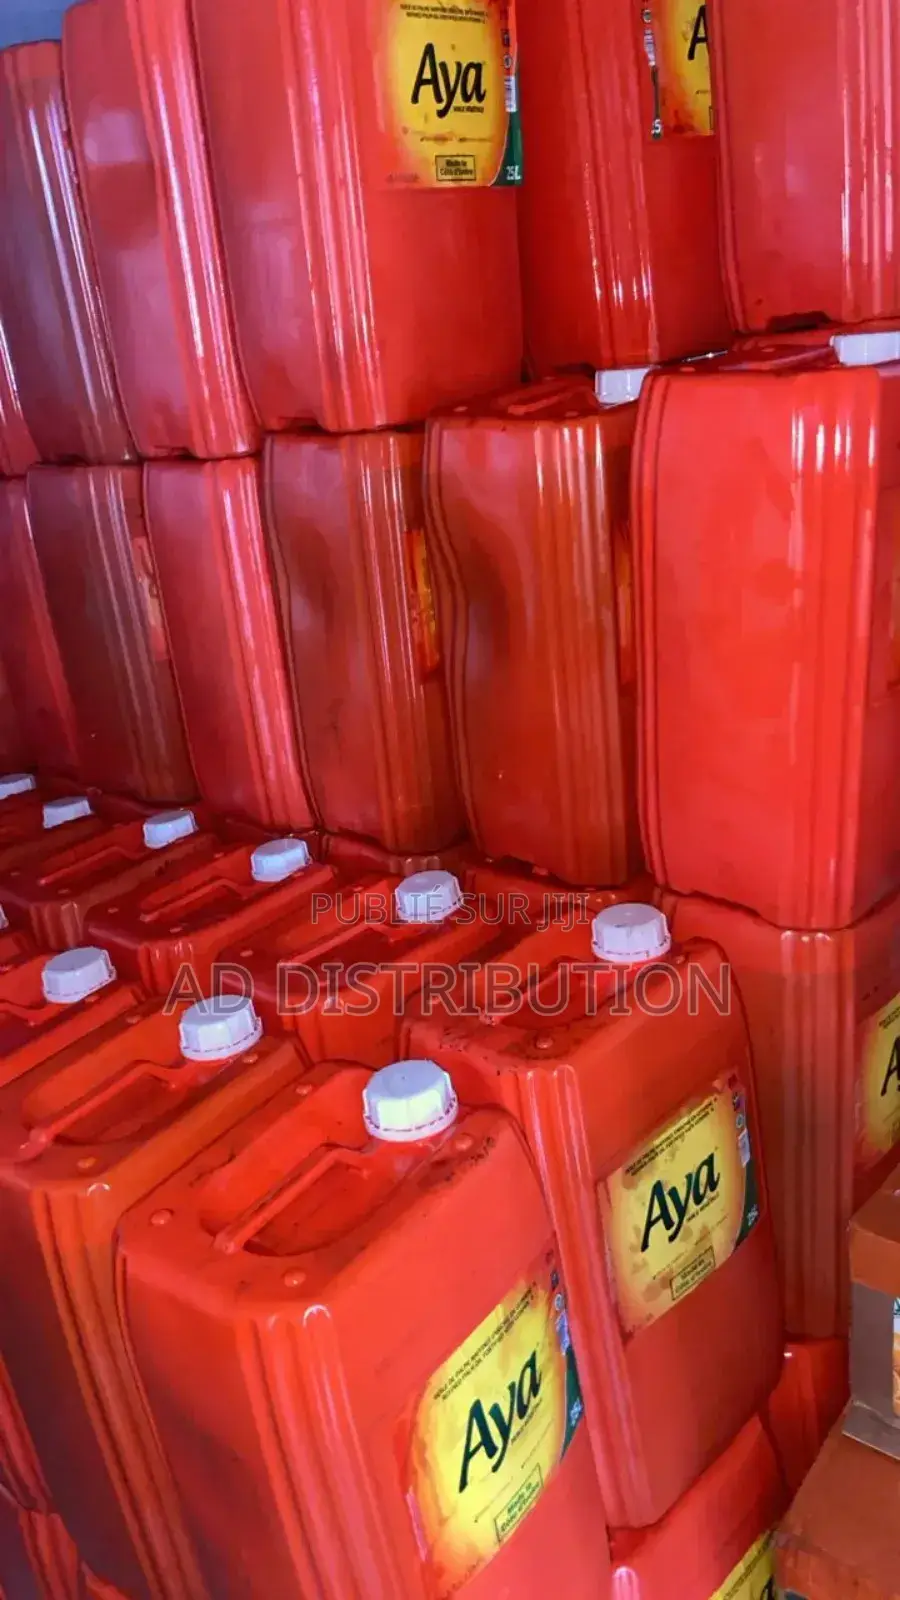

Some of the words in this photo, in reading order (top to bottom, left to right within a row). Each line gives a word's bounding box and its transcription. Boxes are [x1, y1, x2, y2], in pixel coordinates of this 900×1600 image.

[411, 42, 486, 118] Aya
[881, 1035, 900, 1097] A
[641, 1152, 720, 1252] Aya
[459, 1349, 542, 1493] Aya
